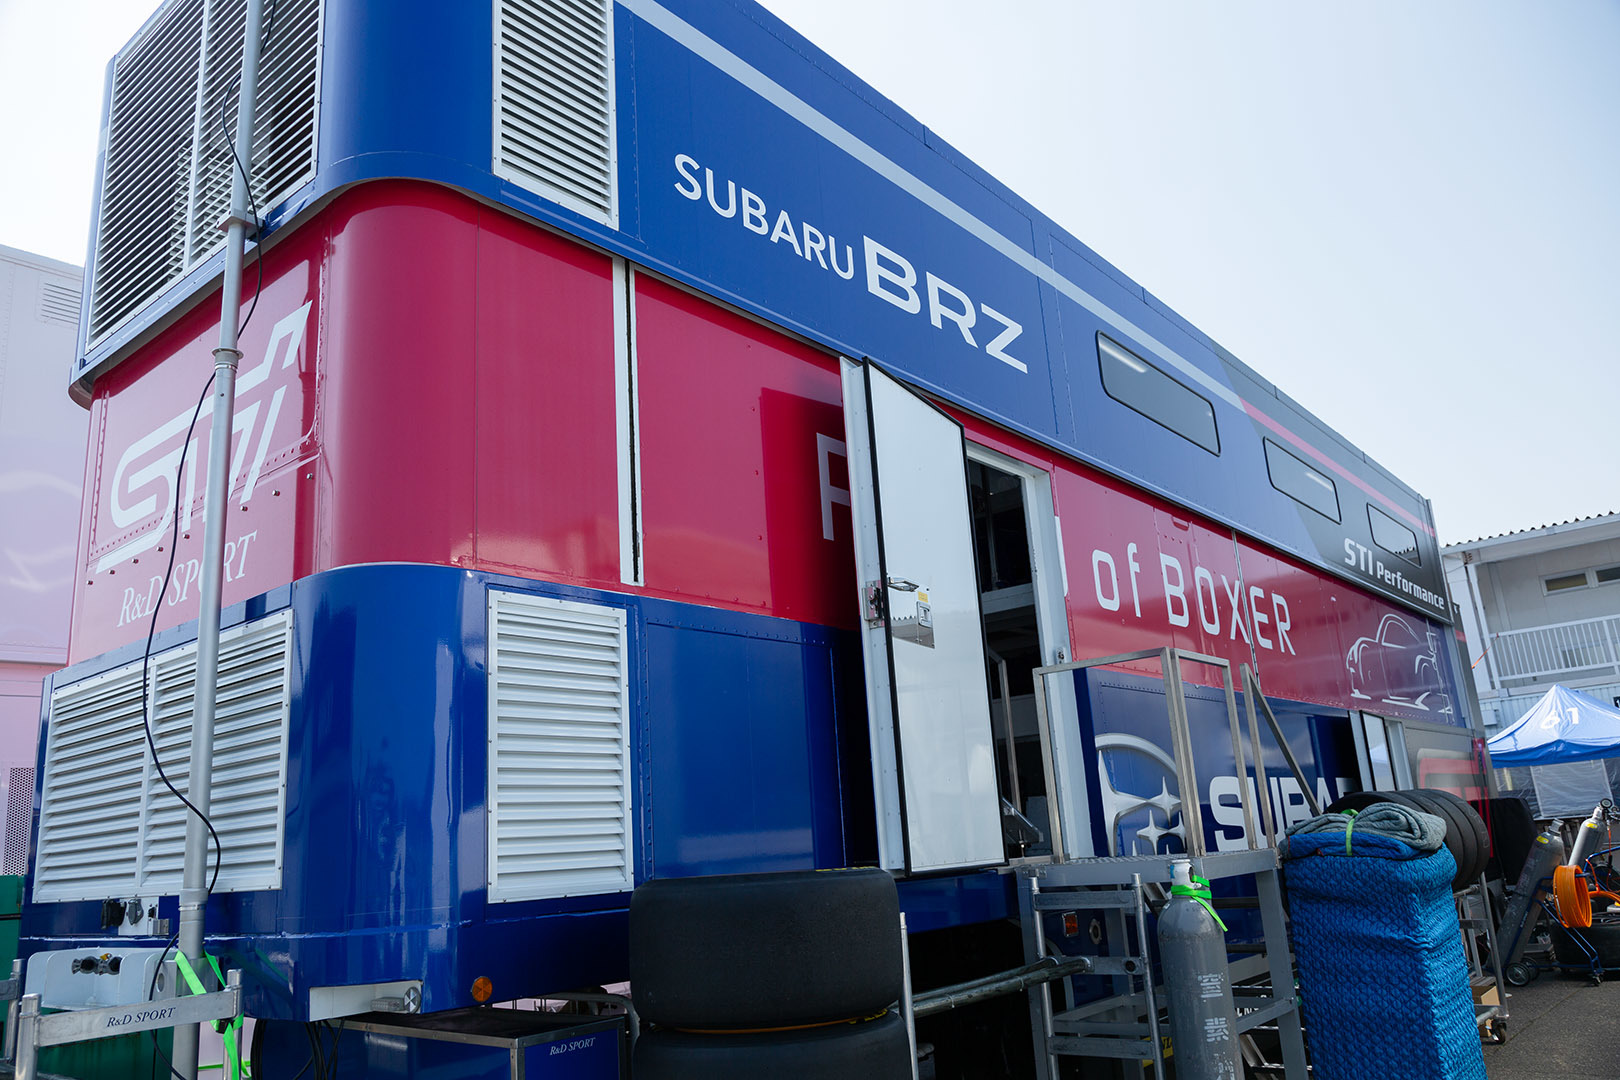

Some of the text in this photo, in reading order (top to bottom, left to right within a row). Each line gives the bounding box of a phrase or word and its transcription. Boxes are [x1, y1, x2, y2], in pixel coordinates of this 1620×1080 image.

[674, 153, 1028, 374] SUBARU BRZ
[116, 531, 258, 628] R&D SPRT
[1092, 542, 1141, 618] of
[1159, 552, 1296, 656] BOXER
[1344, 538, 1445, 610] STI Performance
[107, 1007, 176, 1027] R&D SPORT
[549, 1037, 596, 1055] R&D SPORT
